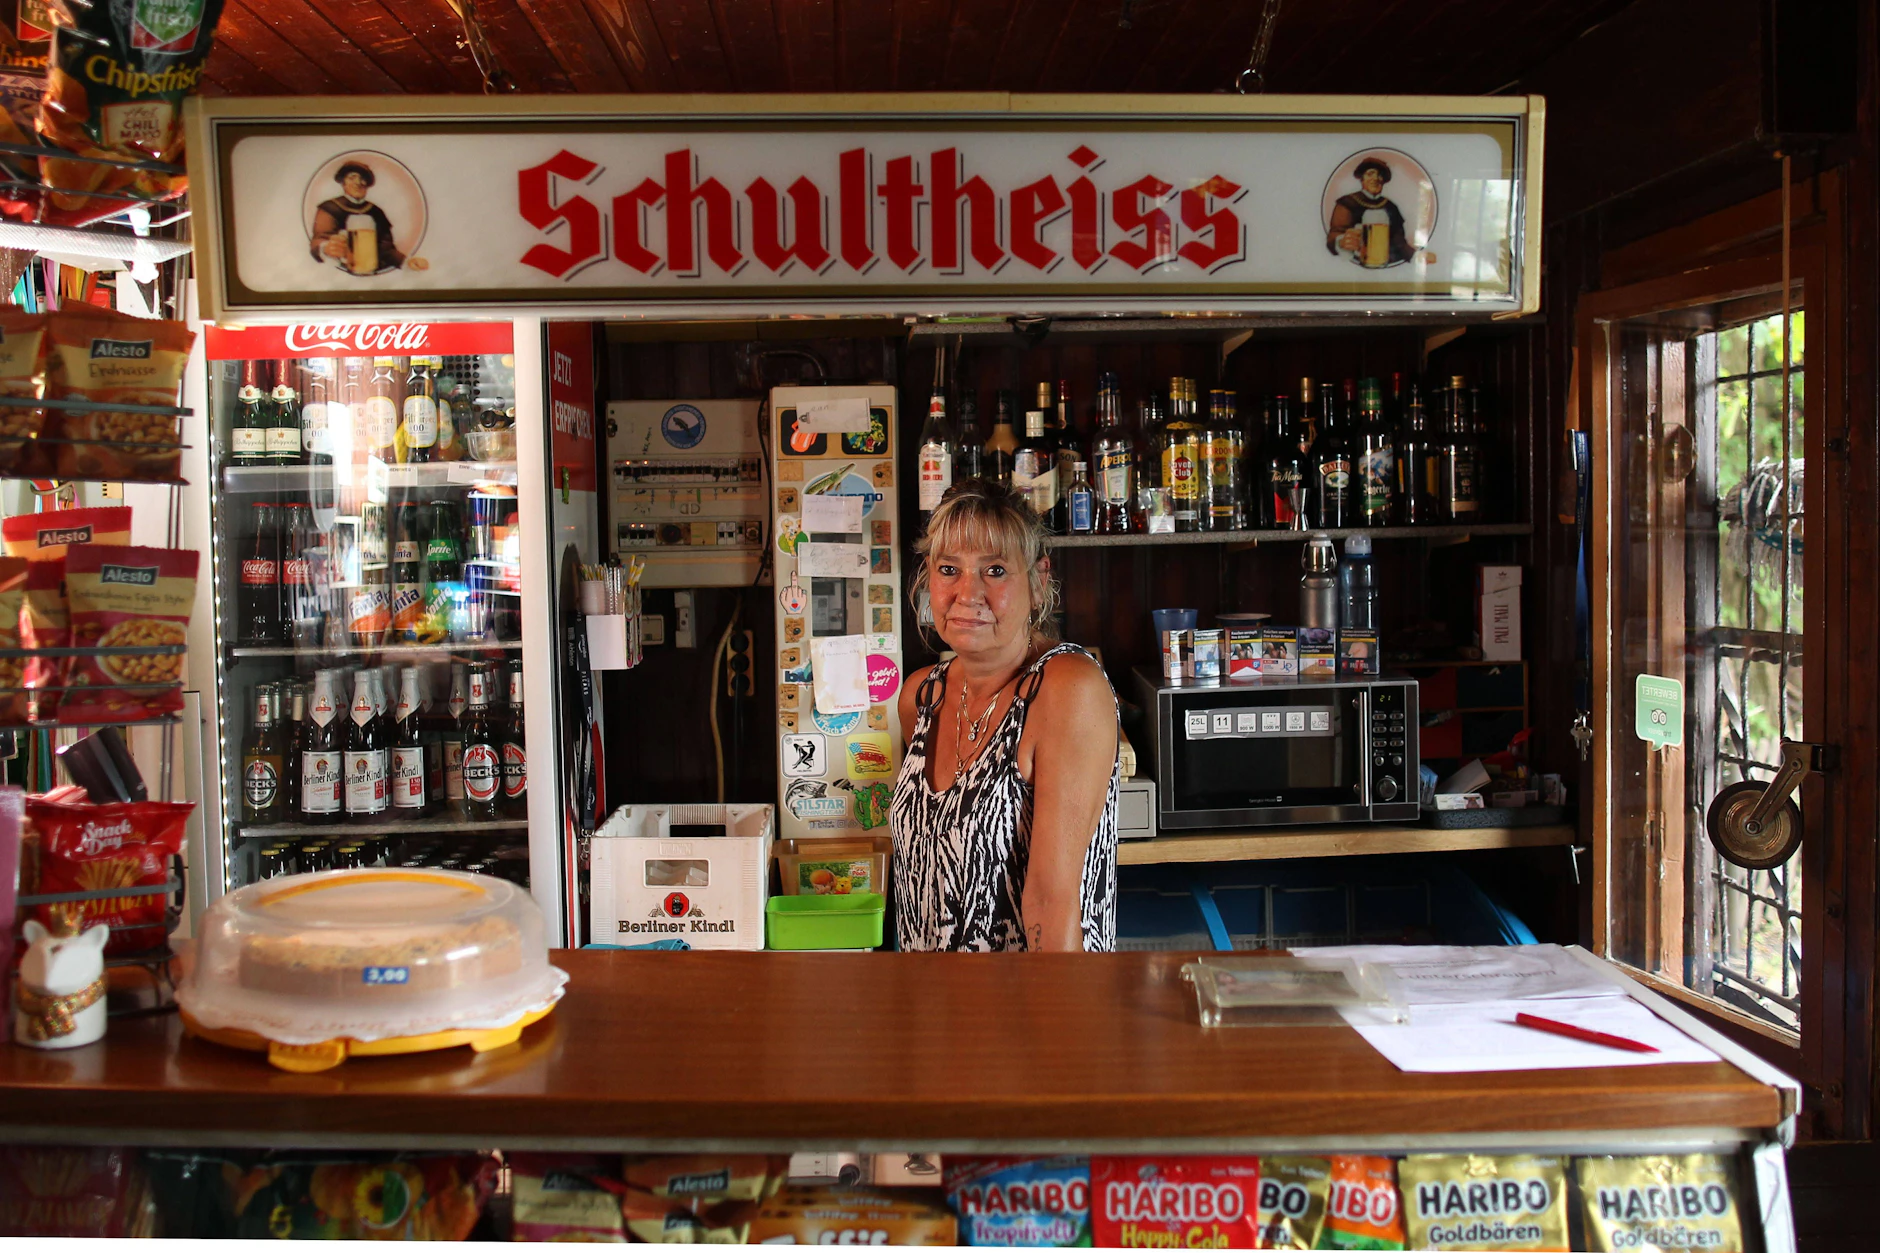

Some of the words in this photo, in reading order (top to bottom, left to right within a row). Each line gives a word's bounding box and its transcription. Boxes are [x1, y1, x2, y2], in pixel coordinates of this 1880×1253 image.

[517, 145, 1249, 283] Schultheiss
[96, 341, 147, 358] Alesto
[553, 350, 572, 388] JETZT
[1100, 453, 1132, 469] APEROL
[40, 532, 88, 545] Alesto
[427, 543, 451, 556] Sprite
[104, 567, 152, 583] Alesto
[1494, 604, 1509, 623] MALL
[1494, 627, 1509, 644] PALL
[1190, 718, 1206, 726] 25L
[1216, 716, 1229, 727] 11
[303, 773, 326, 786] Berliner
[345, 773, 366, 786] Berliner
[401, 765, 419, 778] Kindl
[464, 767, 500, 777] BECK'S
[795, 799, 845, 810] SILSTAR
[84, 820, 132, 843] Snack
[80, 835, 122, 856] Day
[618, 920, 686, 934] Berliner
[690, 920, 735, 933] Kindl
[672, 1174, 725, 1192] Alesto
[958, 1177, 1090, 1217] HARIBO
[1106, 1181, 1245, 1223] HARIBO
[1416, 1178, 1552, 1219] HARIBO
[1599, 1181, 1730, 1221] HARIBO
[974, 1217, 1078, 1246] Tropifrutti
[1428, 1221, 1543, 1245] Goldbären
